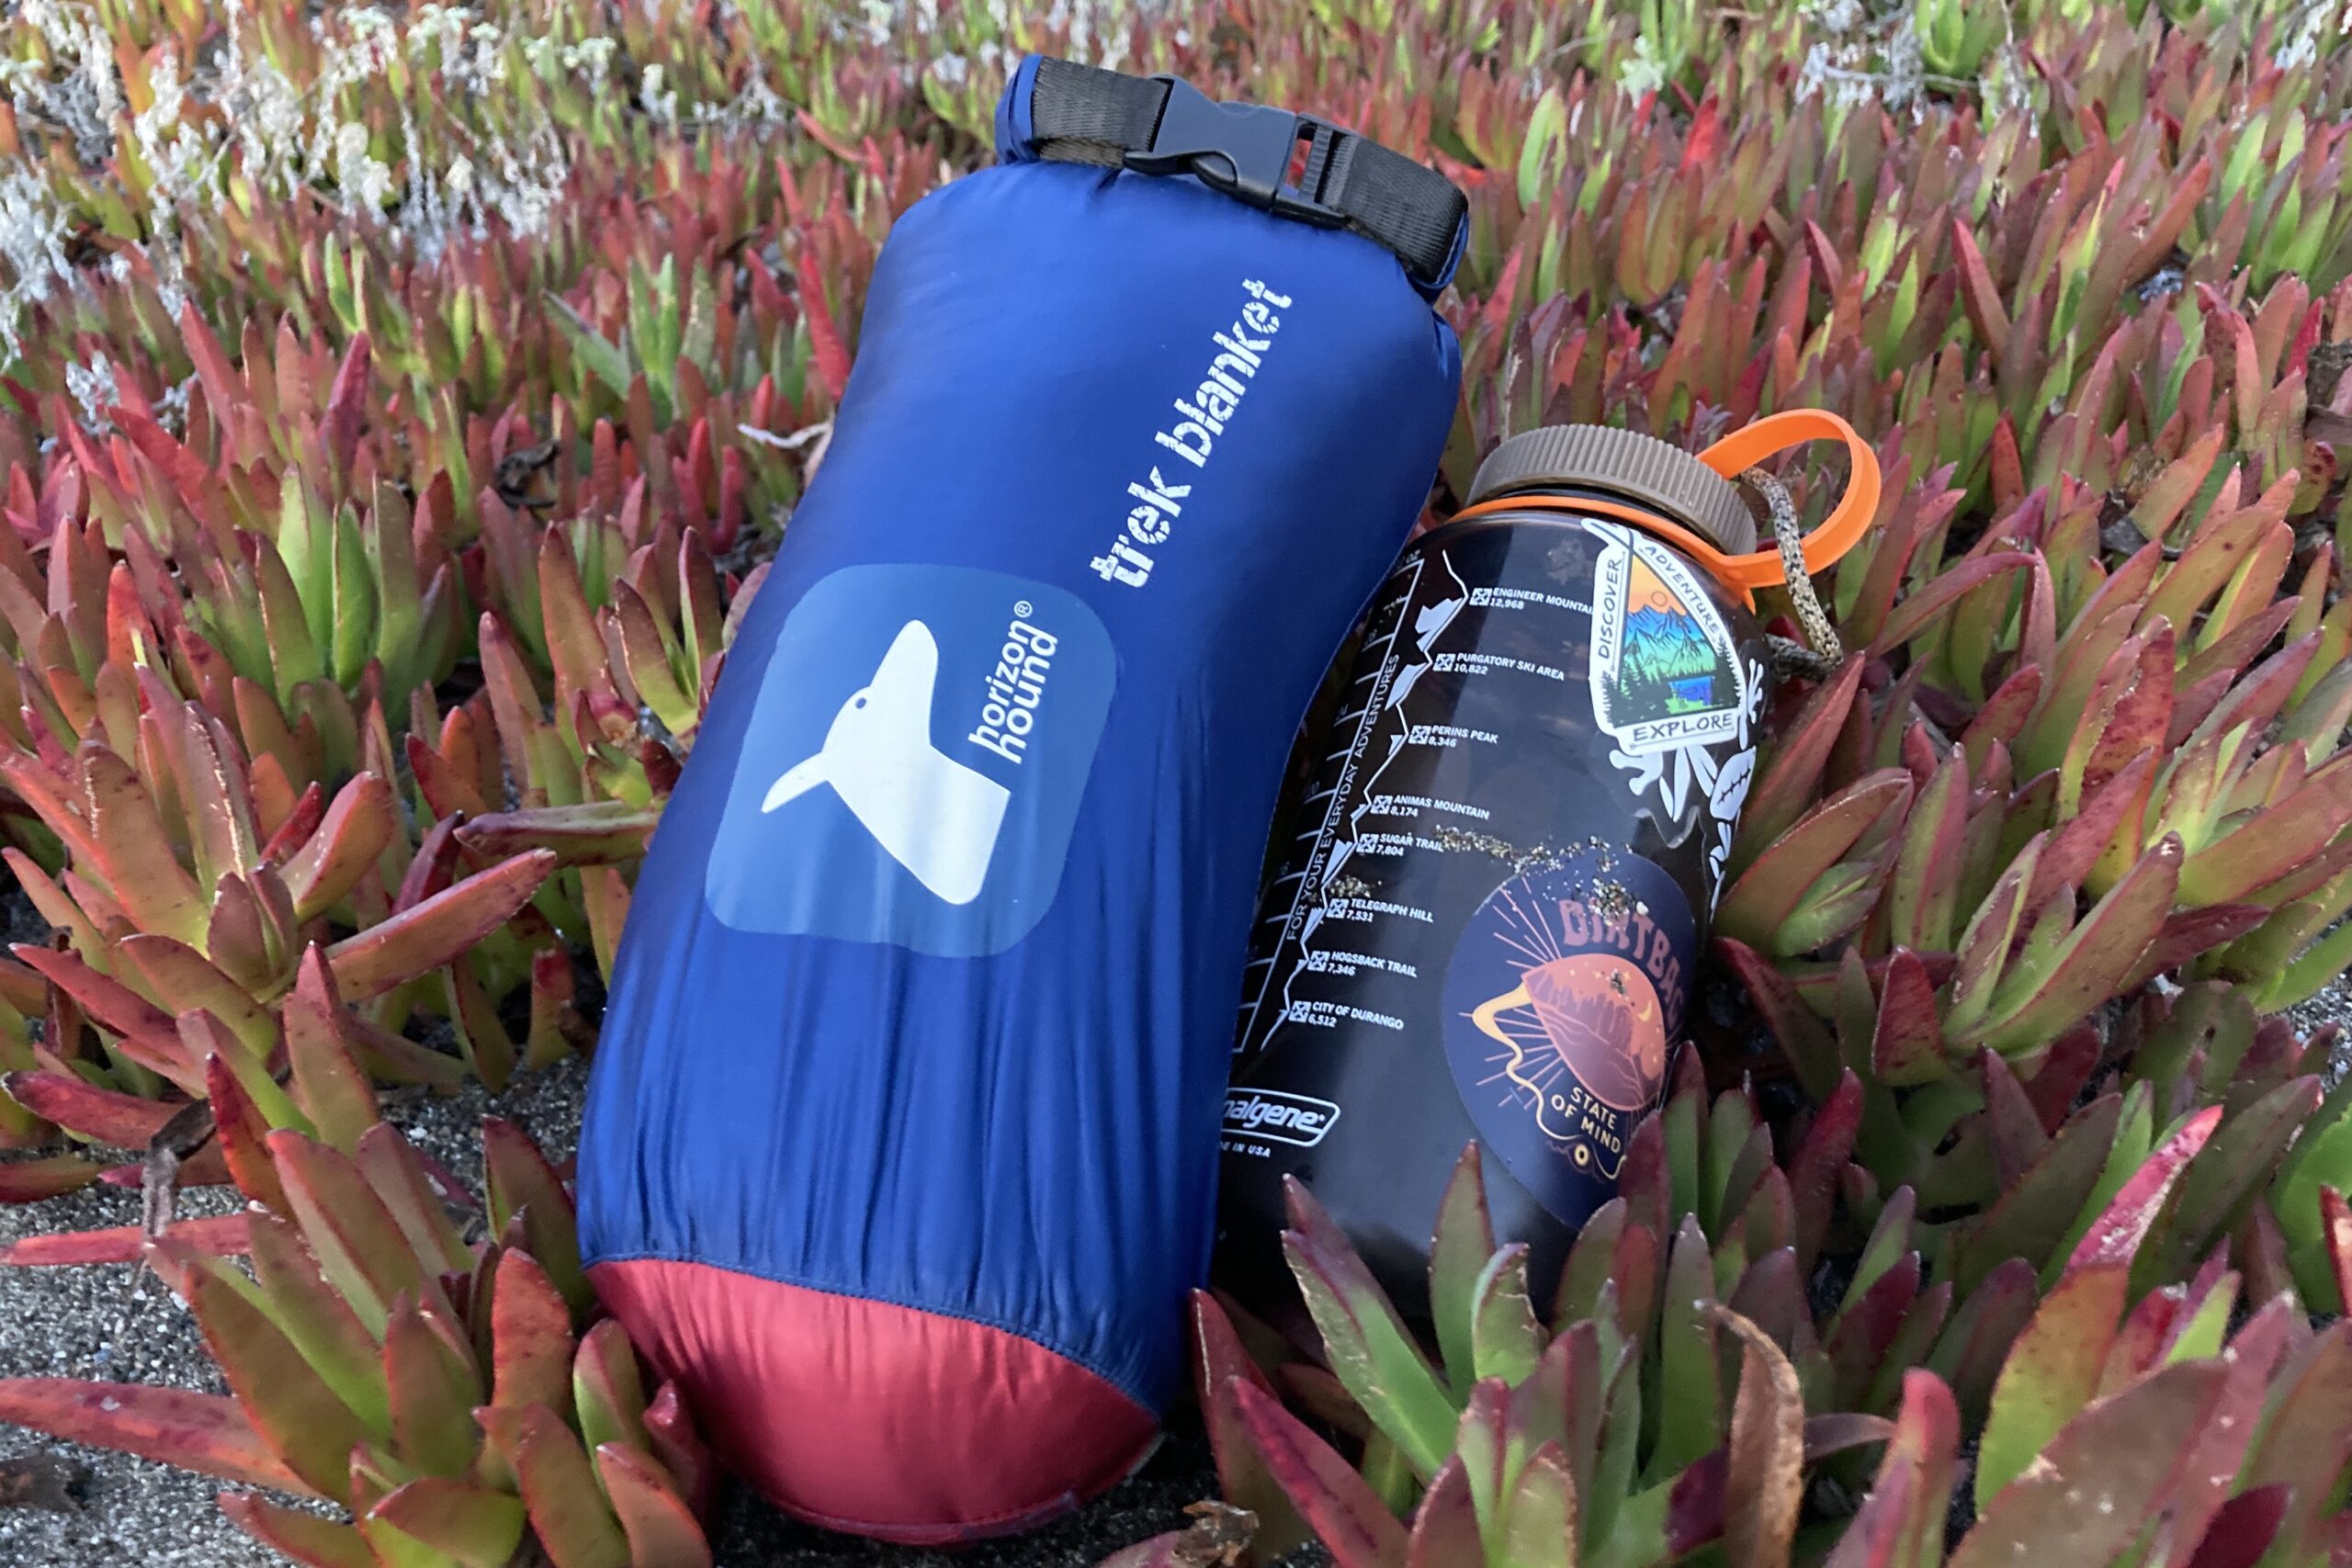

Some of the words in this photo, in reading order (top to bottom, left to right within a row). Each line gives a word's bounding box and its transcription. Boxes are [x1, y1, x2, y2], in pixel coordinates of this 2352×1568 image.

[1090, 465, 1192, 589] trek
[1154, 278, 1293, 468] blanket
[1493, 587, 1544, 603] ENGINEER
[1545, 595, 1593, 615] MOUNTAI
[1645, 544, 1719, 633] ADVENTURE
[1489, 597, 1525, 610] 12,968
[1598, 558, 1622, 660] DISCOVER
[1453, 662, 1488, 675] 10,822
[1457, 652, 1516, 669] PURGATORY
[1516, 660, 1536, 672] SKI
[1536, 666, 1565, 681] AREA
[991, 624, 1059, 765] hound
[1431, 725, 1469, 739] PERINS
[1470, 731, 1498, 744] PEAK
[1633, 712, 1733, 742] EXPLORE
[1286, 904, 1306, 941] FOR
[1304, 852, 1326, 900] YOUR
[1320, 764, 1360, 849] EVERYDAY
[1354, 654, 1400, 759] ADVENTURES
[1394, 795, 1432, 808] ANIMAS
[1433, 800, 1490, 820] MOUNTAIN
[1390, 806, 1419, 818] 8,174
[1376, 844, 1404, 856] 7,804
[1379, 833, 1414, 846] SUGAR
[1416, 837, 1445, 852] TRAIL
[1346, 909, 1374, 922] 7,531
[1351, 898, 1408, 917] TELEGRAPH
[1410, 908, 1433, 922] HILL
[1327, 963, 1356, 976] 7,346
[1332, 952, 1385, 970] HOGSBACK
[1386, 960, 1418, 977] TRAIL
[1312, 1001, 1336, 1013] CITY
[1333, 1004, 1350, 1016] OF
[1350, 1007, 1404, 1030] DURANGO
[1570, 1087, 1618, 1130] STATE
[1551, 1094, 1577, 1119] OF
[1580, 1115, 1621, 1153] MIND
[1232, 1142, 1245, 1153] IN
[1248, 1145, 1271, 1157] USA
